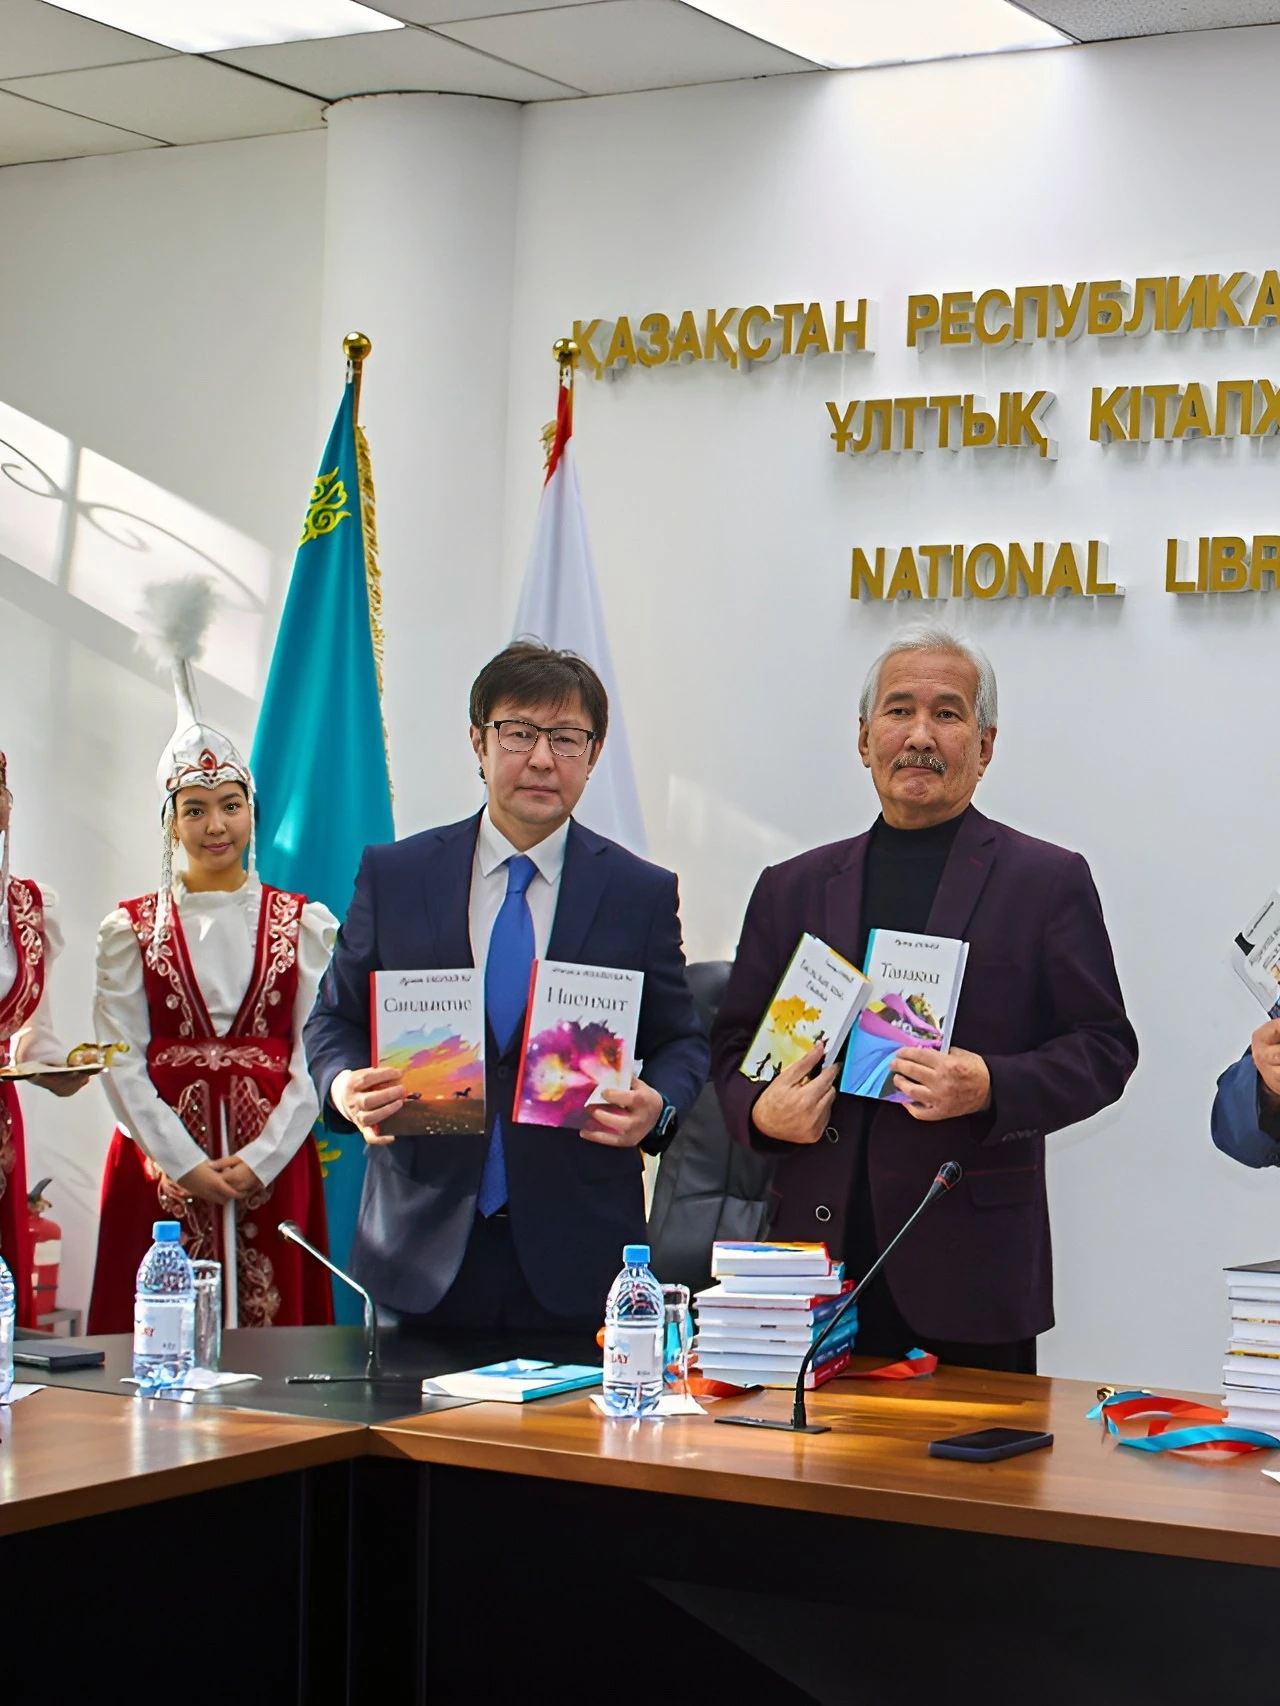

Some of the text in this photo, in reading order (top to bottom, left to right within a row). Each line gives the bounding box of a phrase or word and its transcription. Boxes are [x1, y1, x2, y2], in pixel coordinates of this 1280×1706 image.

[572, 299, 868, 380] ҚАЗАҚСТАН
[826, 391, 1050, 459] ҰЛТТЫҚ
[850, 540, 1117, 600] NATIONAL
